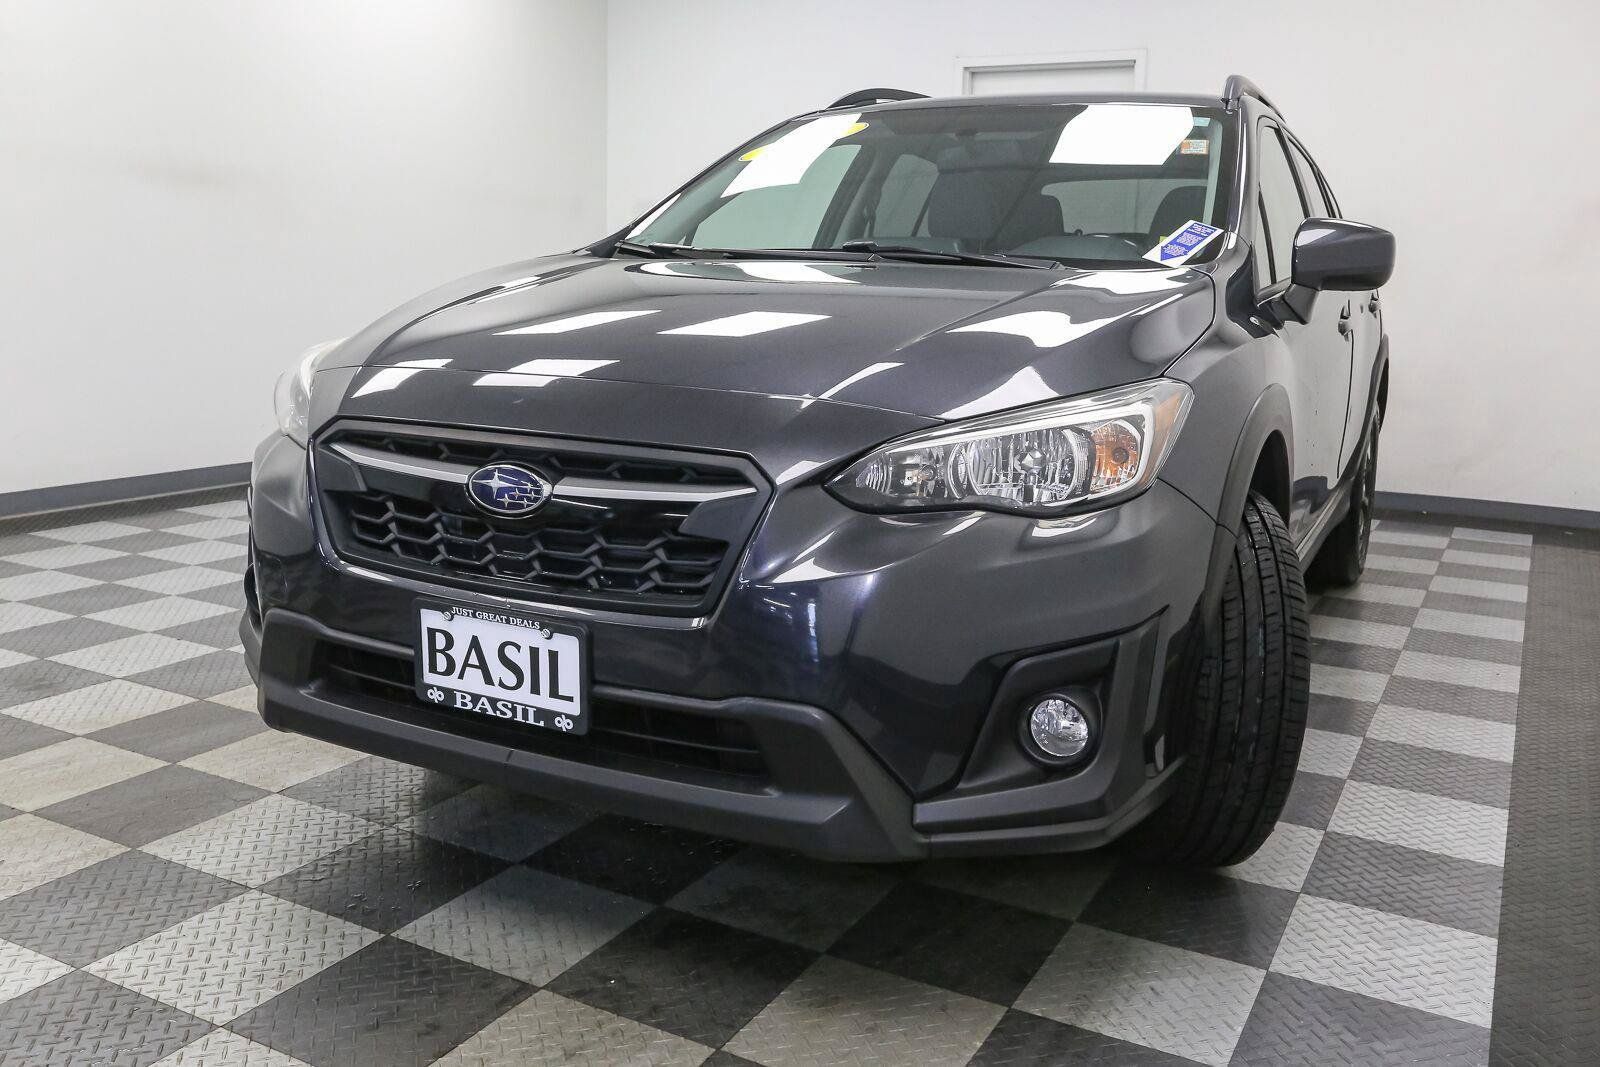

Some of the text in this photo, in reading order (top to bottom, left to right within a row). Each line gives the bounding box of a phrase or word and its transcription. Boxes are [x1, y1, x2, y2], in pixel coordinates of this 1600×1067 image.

[451, 606, 540, 630] JUST GREAT DEALS
[427, 626, 574, 702] BASIL
[453, 690, 545, 727] BASIL
